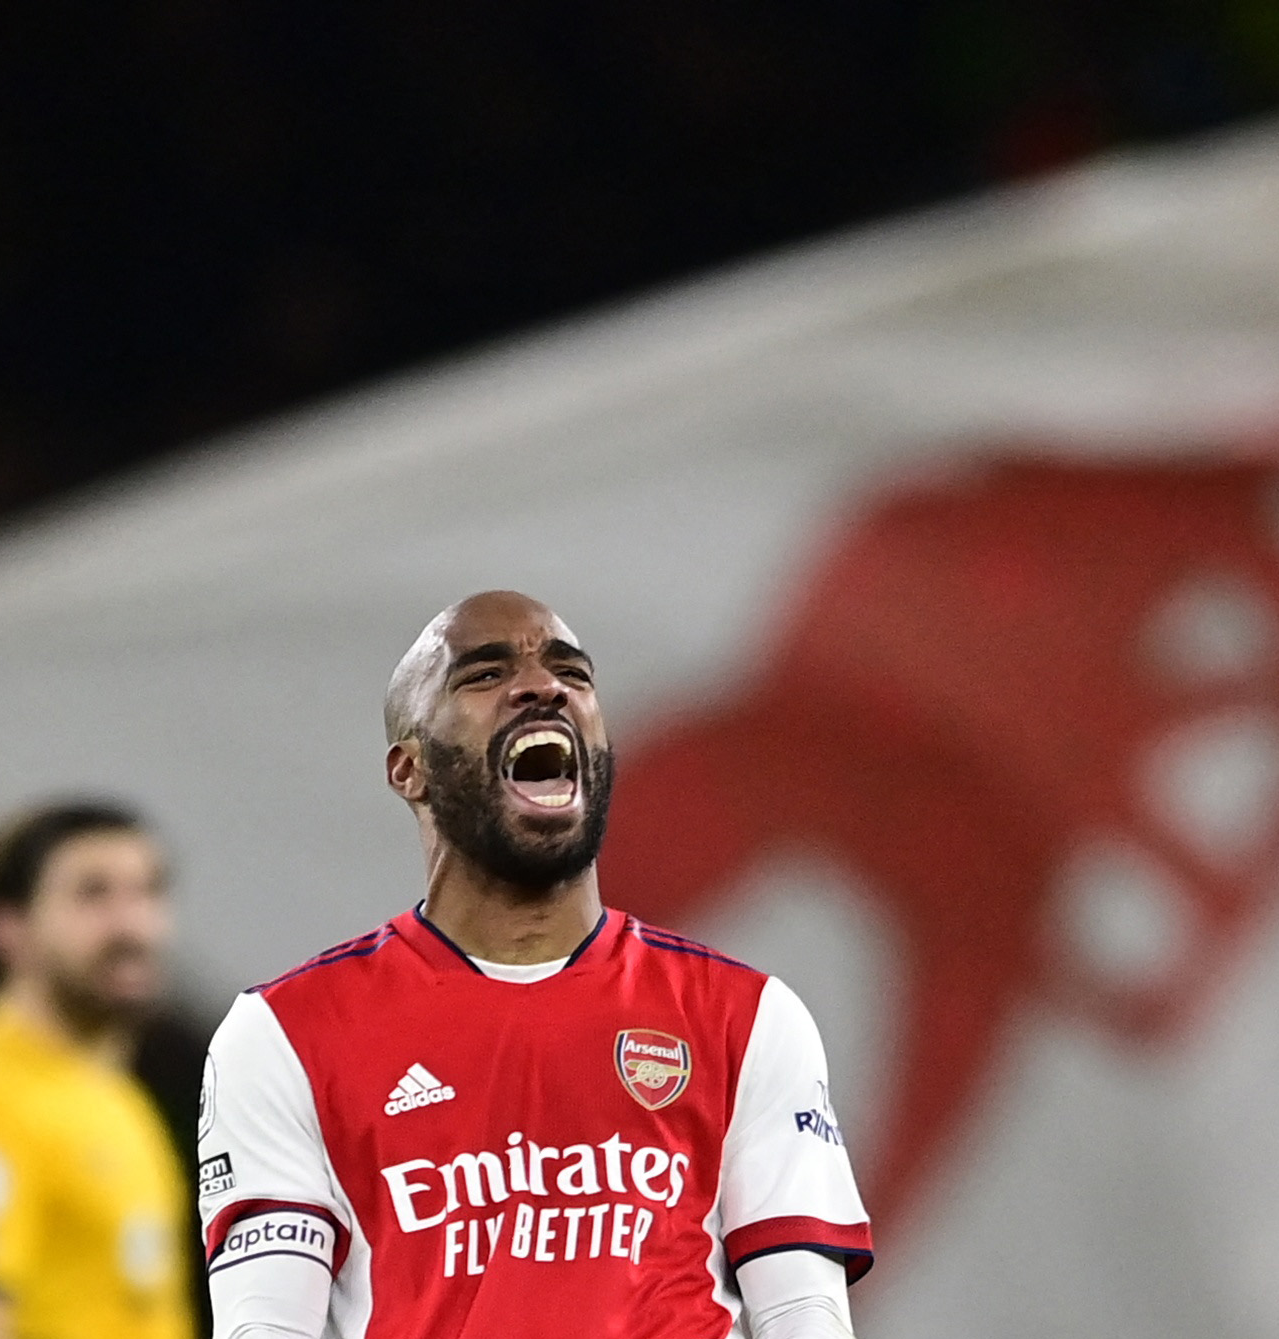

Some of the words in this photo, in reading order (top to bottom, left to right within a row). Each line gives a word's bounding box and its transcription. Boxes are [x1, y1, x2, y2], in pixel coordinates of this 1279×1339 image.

[625, 1039, 679, 1060] Arsenal
[384, 1085, 456, 1117] adidas
[380, 1131, 690, 1233] Emirates
[227, 1219, 326, 1253] aptain
[444, 1212, 505, 1277] FLY
[510, 1203, 653, 1265] BETTER
